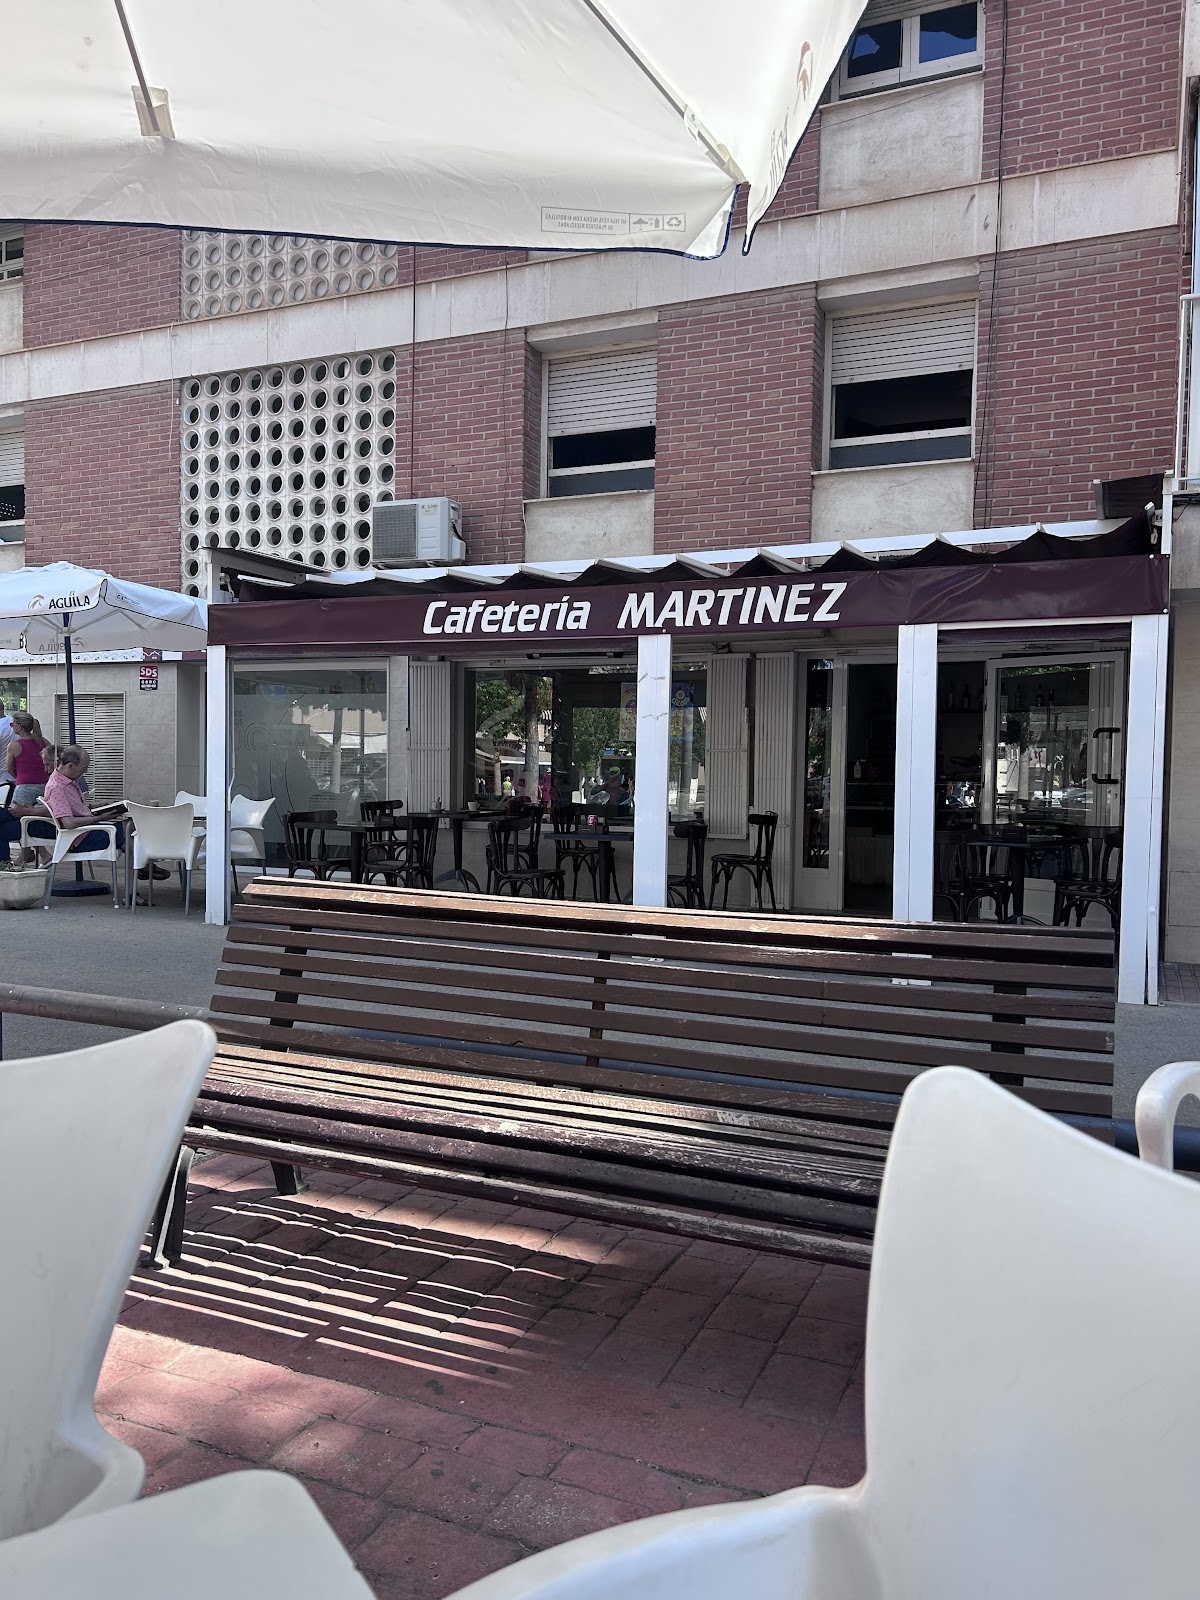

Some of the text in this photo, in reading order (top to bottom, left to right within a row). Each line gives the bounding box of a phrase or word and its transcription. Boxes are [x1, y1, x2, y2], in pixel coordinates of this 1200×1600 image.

[423, 582, 848, 635] Cafetería MARTINEZ
[140, 666, 158, 678] SDS
